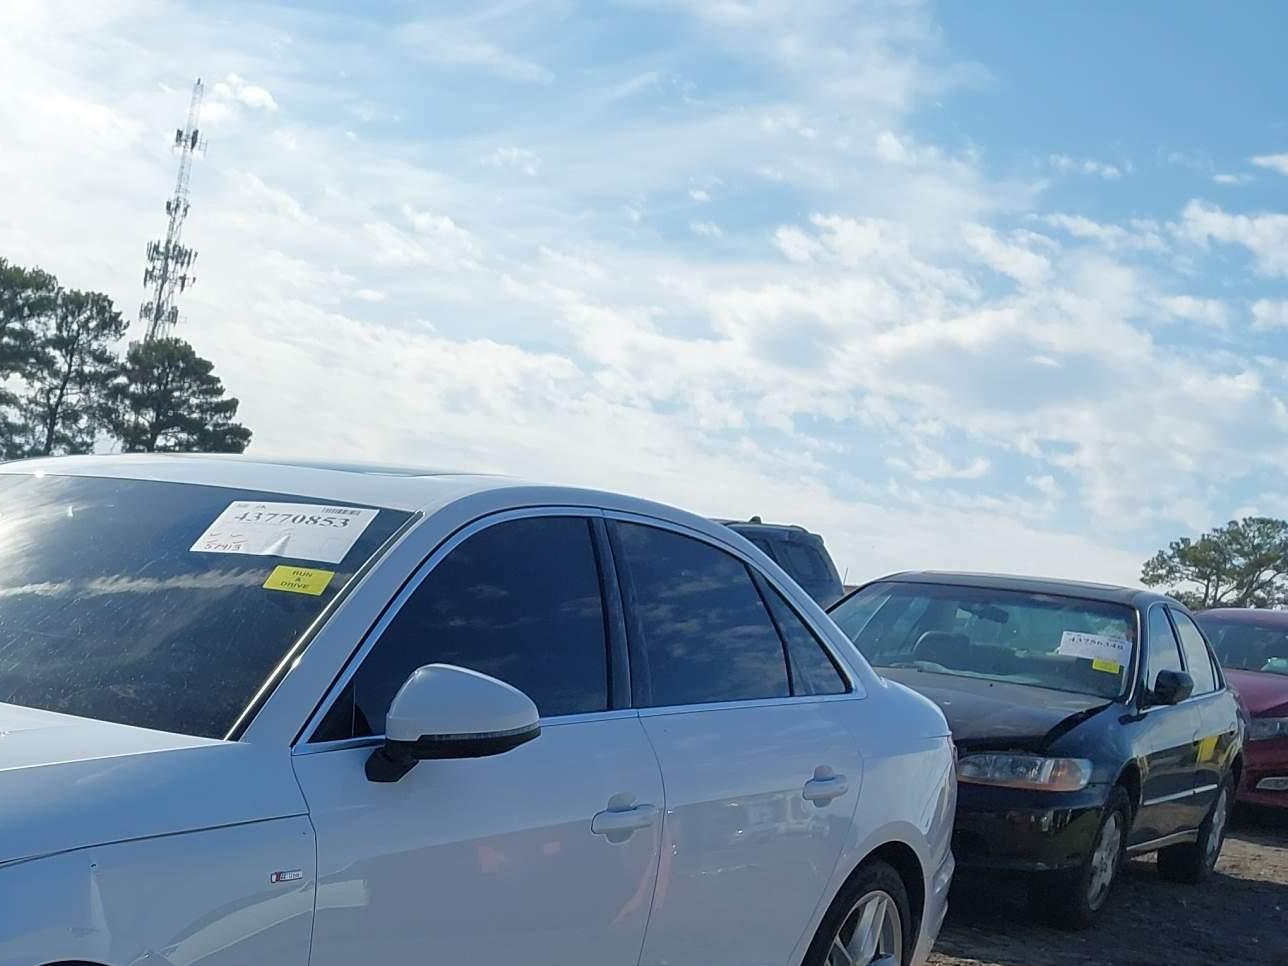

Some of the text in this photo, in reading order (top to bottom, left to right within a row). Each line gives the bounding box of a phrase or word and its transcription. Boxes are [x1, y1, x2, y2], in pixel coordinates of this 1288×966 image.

[234, 510, 350, 528] 43770853
[292, 569, 313, 577] RUN
[279, 580, 312, 589] DRIVE
